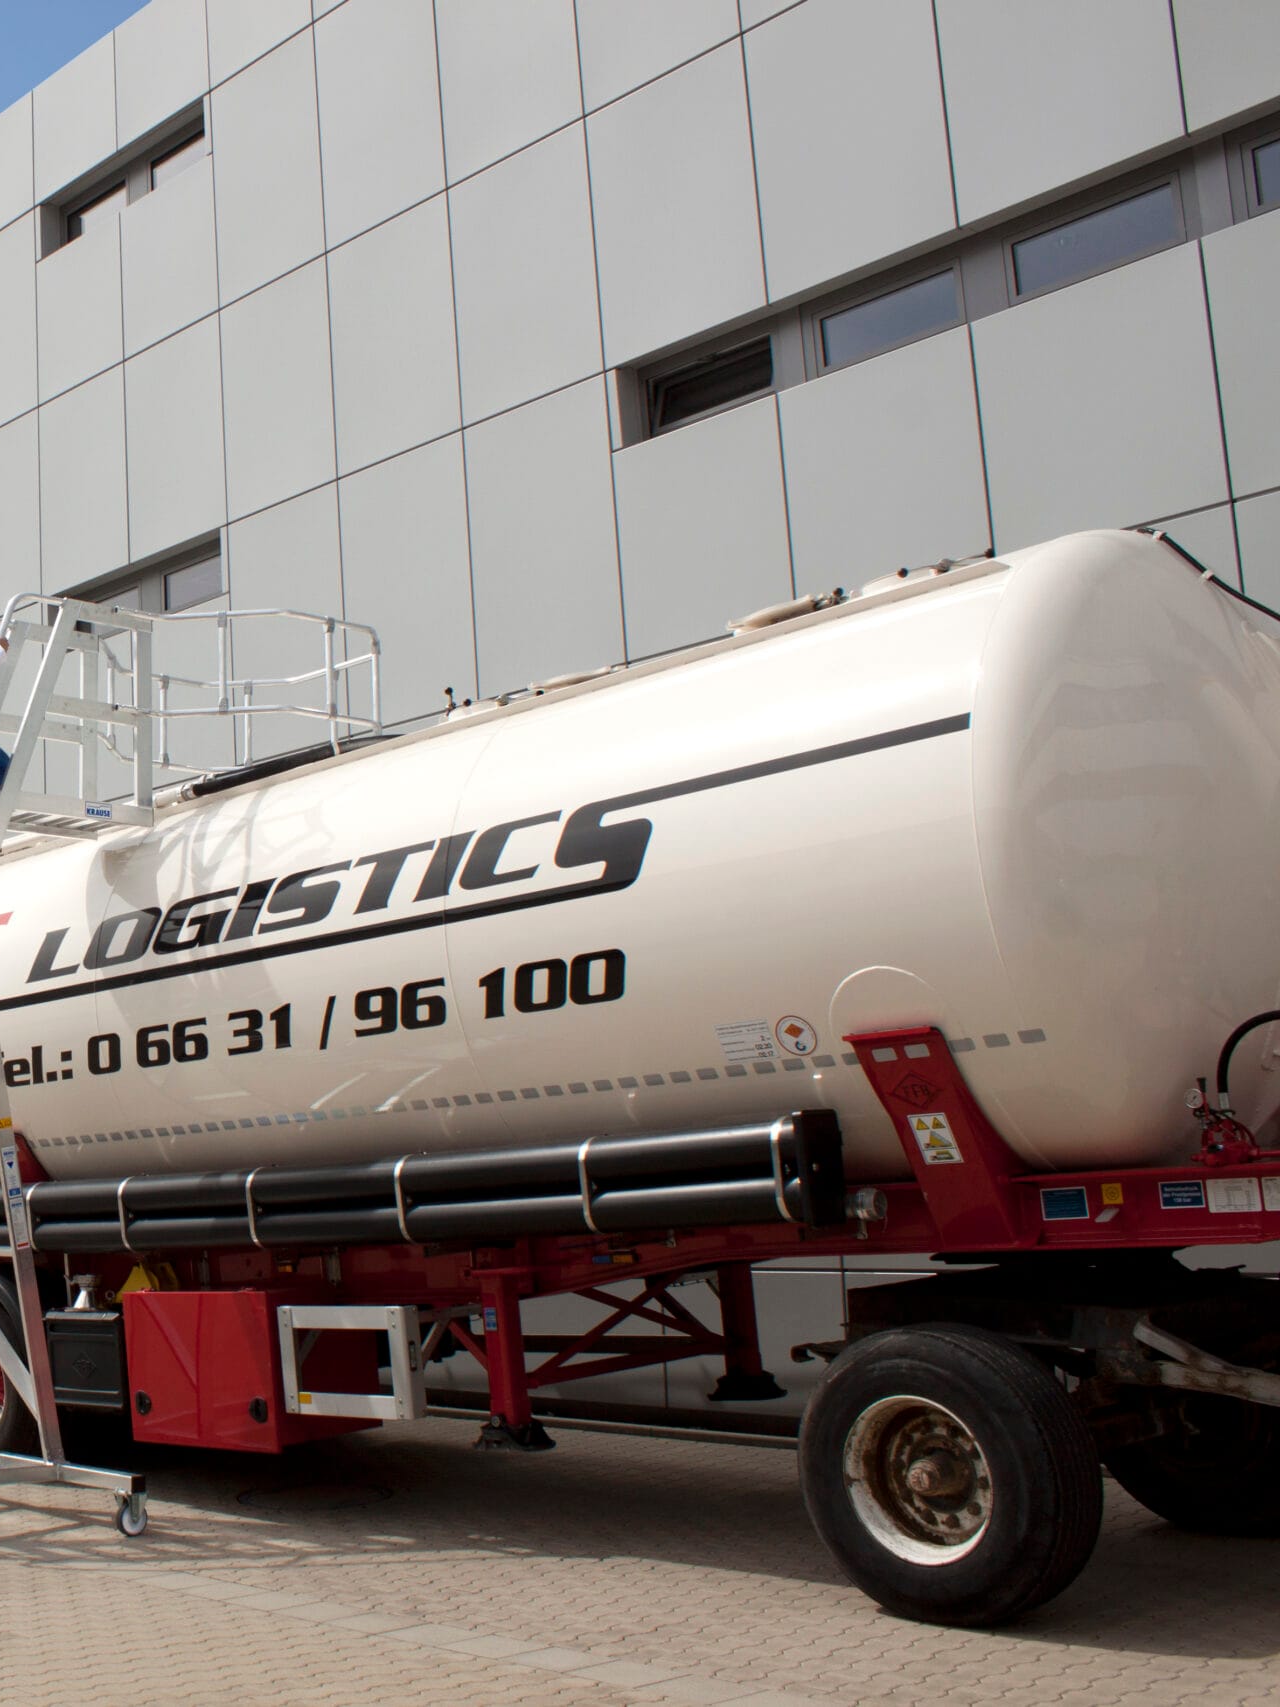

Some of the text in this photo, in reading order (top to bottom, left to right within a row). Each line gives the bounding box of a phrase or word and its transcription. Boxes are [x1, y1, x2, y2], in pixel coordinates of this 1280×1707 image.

[86, 807, 111, 818] KRAUSE
[26, 792, 654, 984] LOGISTICS
[87, 1032, 122, 1076] 0
[135, 1017, 209, 1069] 66
[227, 1002, 292, 1057] 31
[319, 995, 337, 1051] /
[354, 977, 447, 1038] 96
[478, 948, 626, 1020] 100
